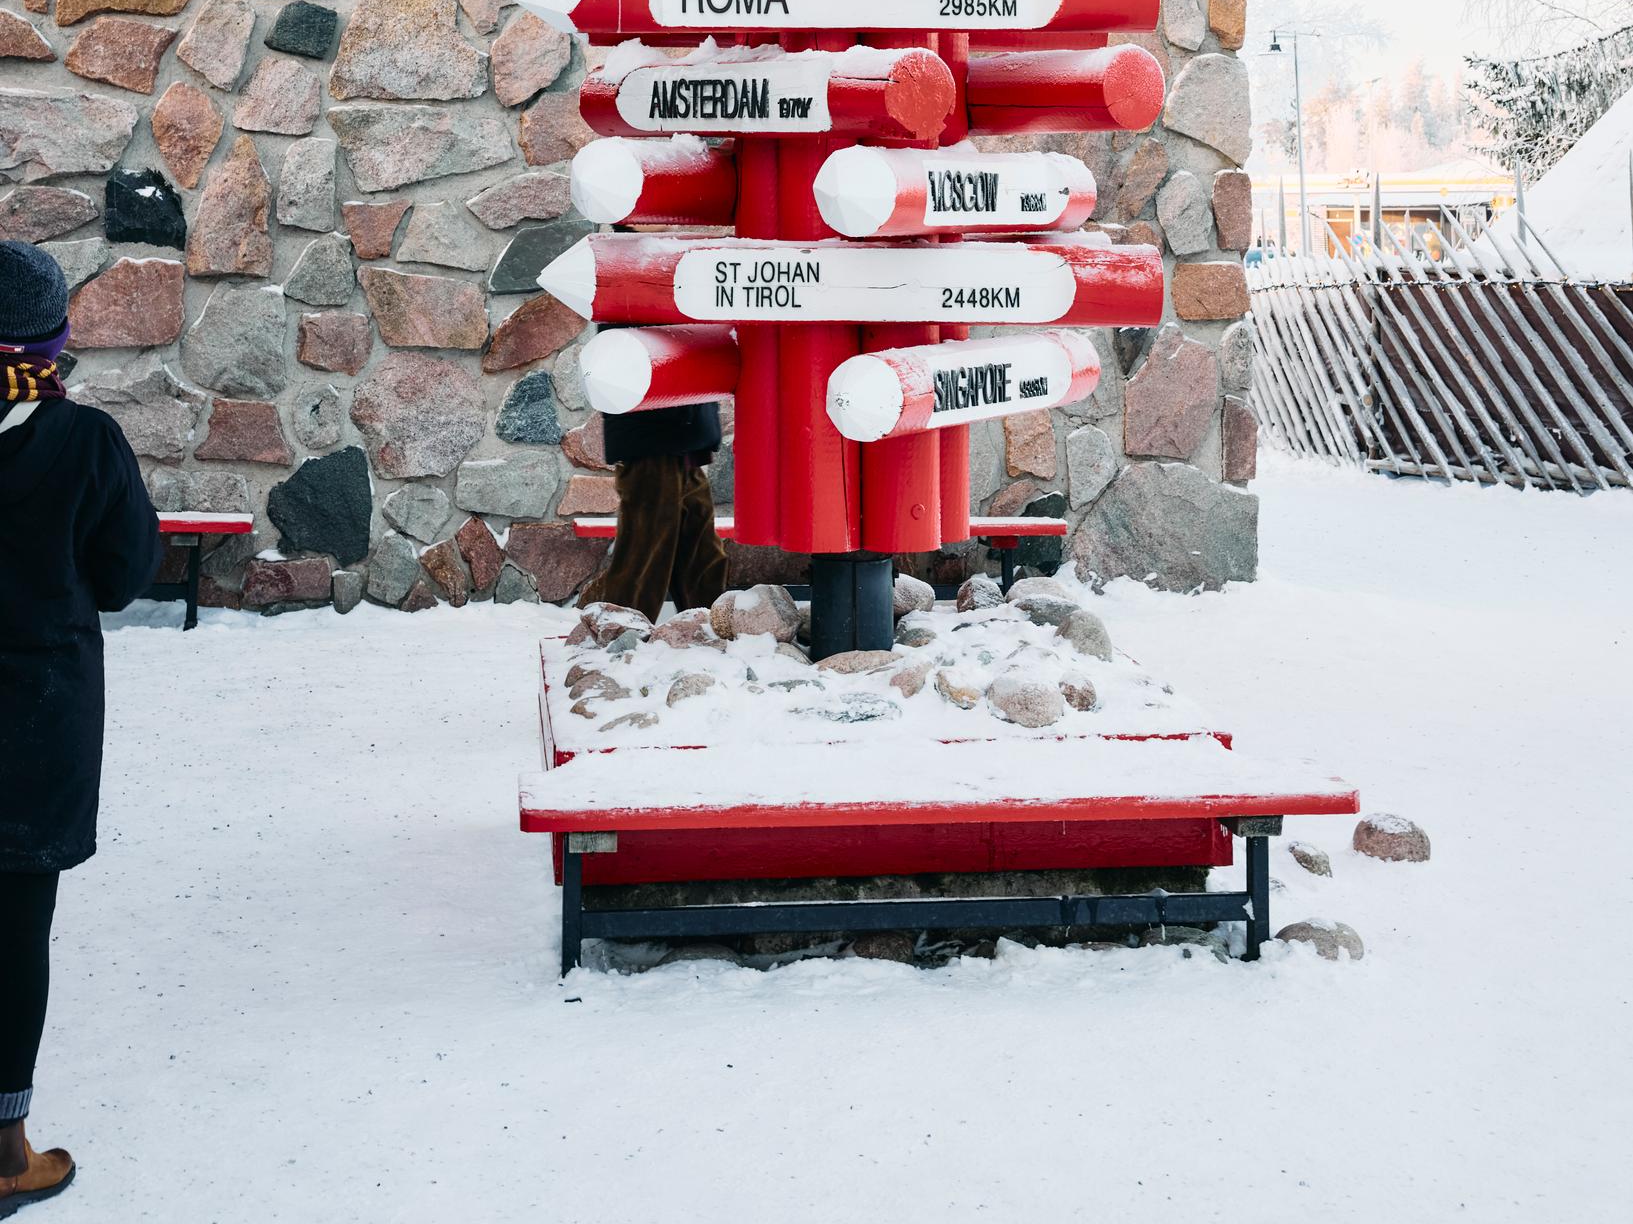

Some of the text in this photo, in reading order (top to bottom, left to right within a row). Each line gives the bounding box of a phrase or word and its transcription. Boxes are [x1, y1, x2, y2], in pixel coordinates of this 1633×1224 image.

[649, 78, 770, 119] AMSTERDAM
[715, 261, 820, 284] ST JOHAN
[715, 285, 1021, 309] IN TIROL 2448KM
[933, 363, 1012, 413] SINGAPORE
